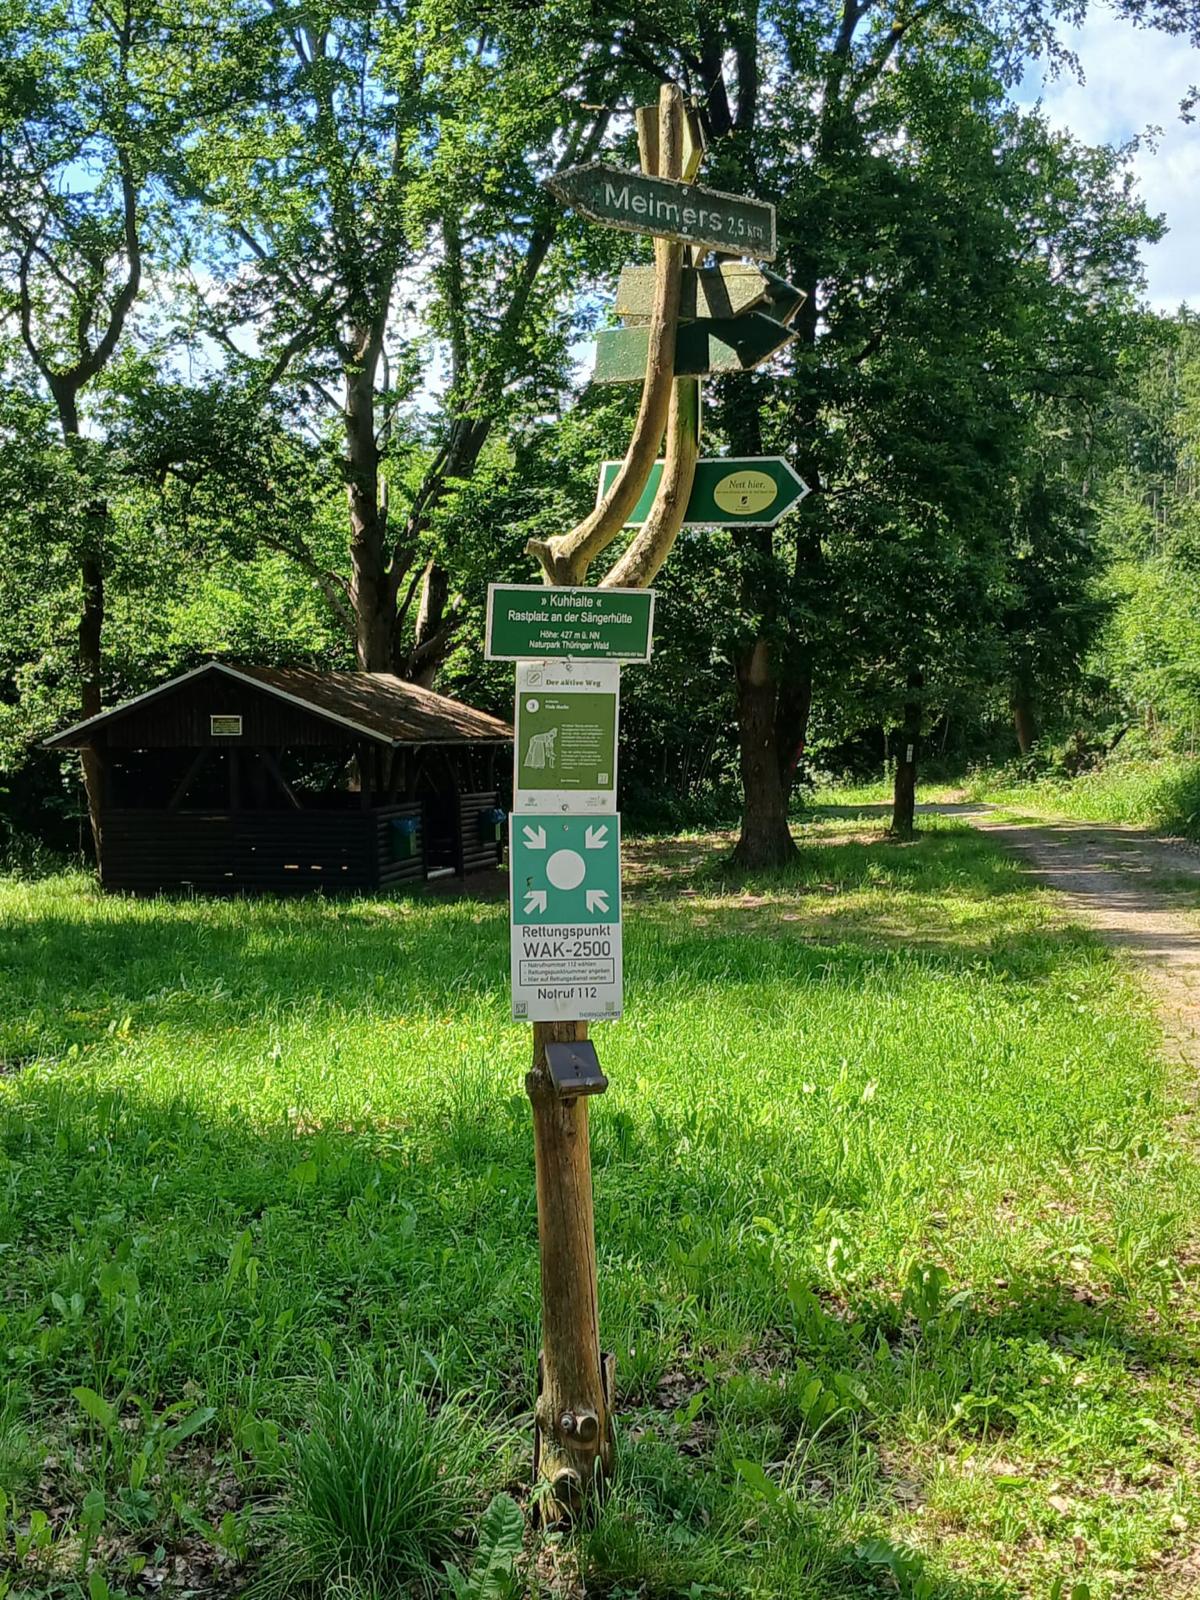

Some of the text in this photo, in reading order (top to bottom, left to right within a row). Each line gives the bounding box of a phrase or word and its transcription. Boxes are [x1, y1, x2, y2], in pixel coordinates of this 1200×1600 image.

[604, 182, 723, 231] Meimers
[727, 216, 744, 237] 2,5
[728, 480, 766, 489] Nett hier.
[549, 594, 593, 607] Kuhhalte
[508, 610, 633, 625] Rastplatz an der Sängerhütte
[539, 630, 559, 639] Höhe:
[560, 631, 573, 639] 427
[589, 631, 600, 640] NN
[529, 640, 609, 651] Naturpark Thüringer Wald
[522, 925, 611, 940] Rettungspunkt
[523, 941, 611, 958] WAK-2500
[537, 986, 597, 999] Notruf 112
